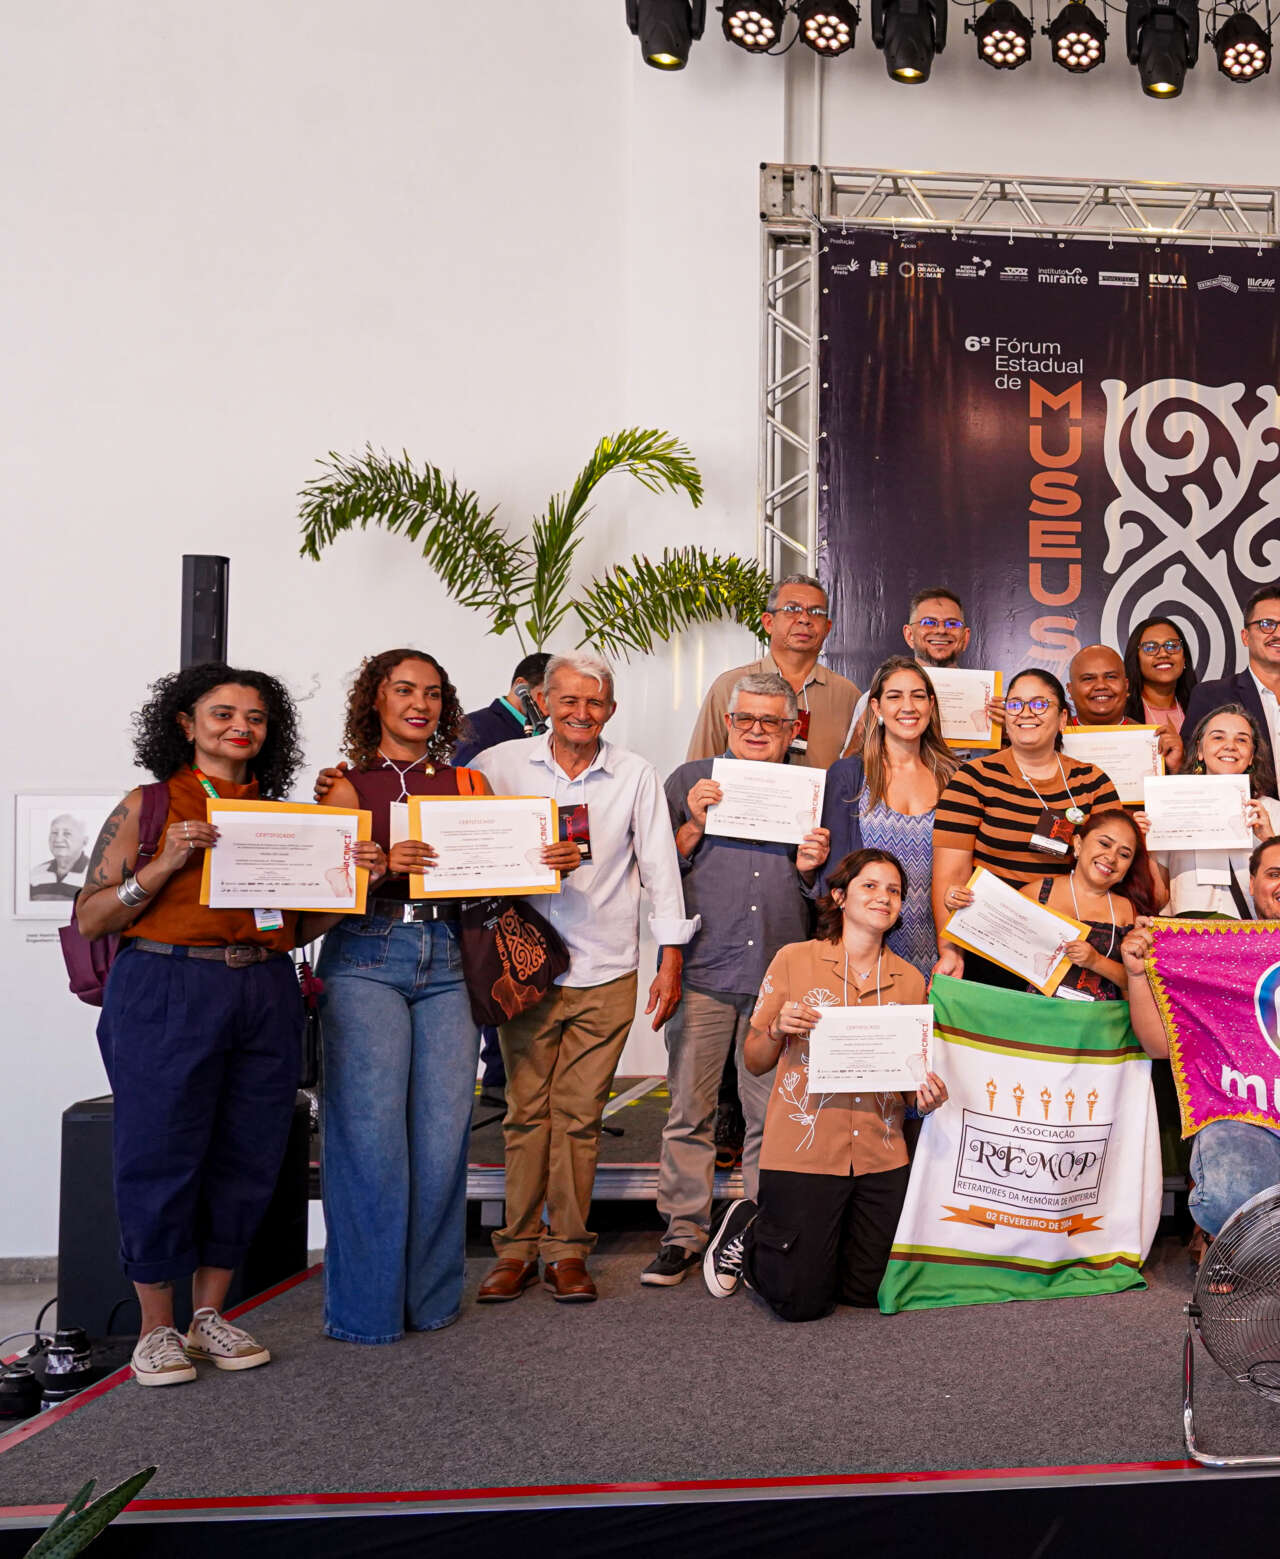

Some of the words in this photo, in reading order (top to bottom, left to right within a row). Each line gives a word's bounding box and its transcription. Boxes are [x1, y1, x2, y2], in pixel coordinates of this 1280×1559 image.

[1038, 267, 1066, 275] Instituto
[1038, 273, 1089, 285] mirante
[965, 336, 990, 351] 6º
[995, 336, 1061, 355] Fórum
[995, 355, 1084, 374] Estadual
[995, 374, 1022, 390] de
[1028, 378, 1083, 662] MUSEUS
[1012, 1125, 1076, 1139] ASSOCIAÇÃO
[957, 1181, 1007, 1199] RETRATORES
[1008, 1191, 1020, 1201] DA
[1021, 1193, 1060, 1207] MEMÓRIA
[986, 1211, 997, 1221] 02
[999, 1214, 1047, 1229] FEVEREIRO
[1048, 1221, 1059, 1231] DE
